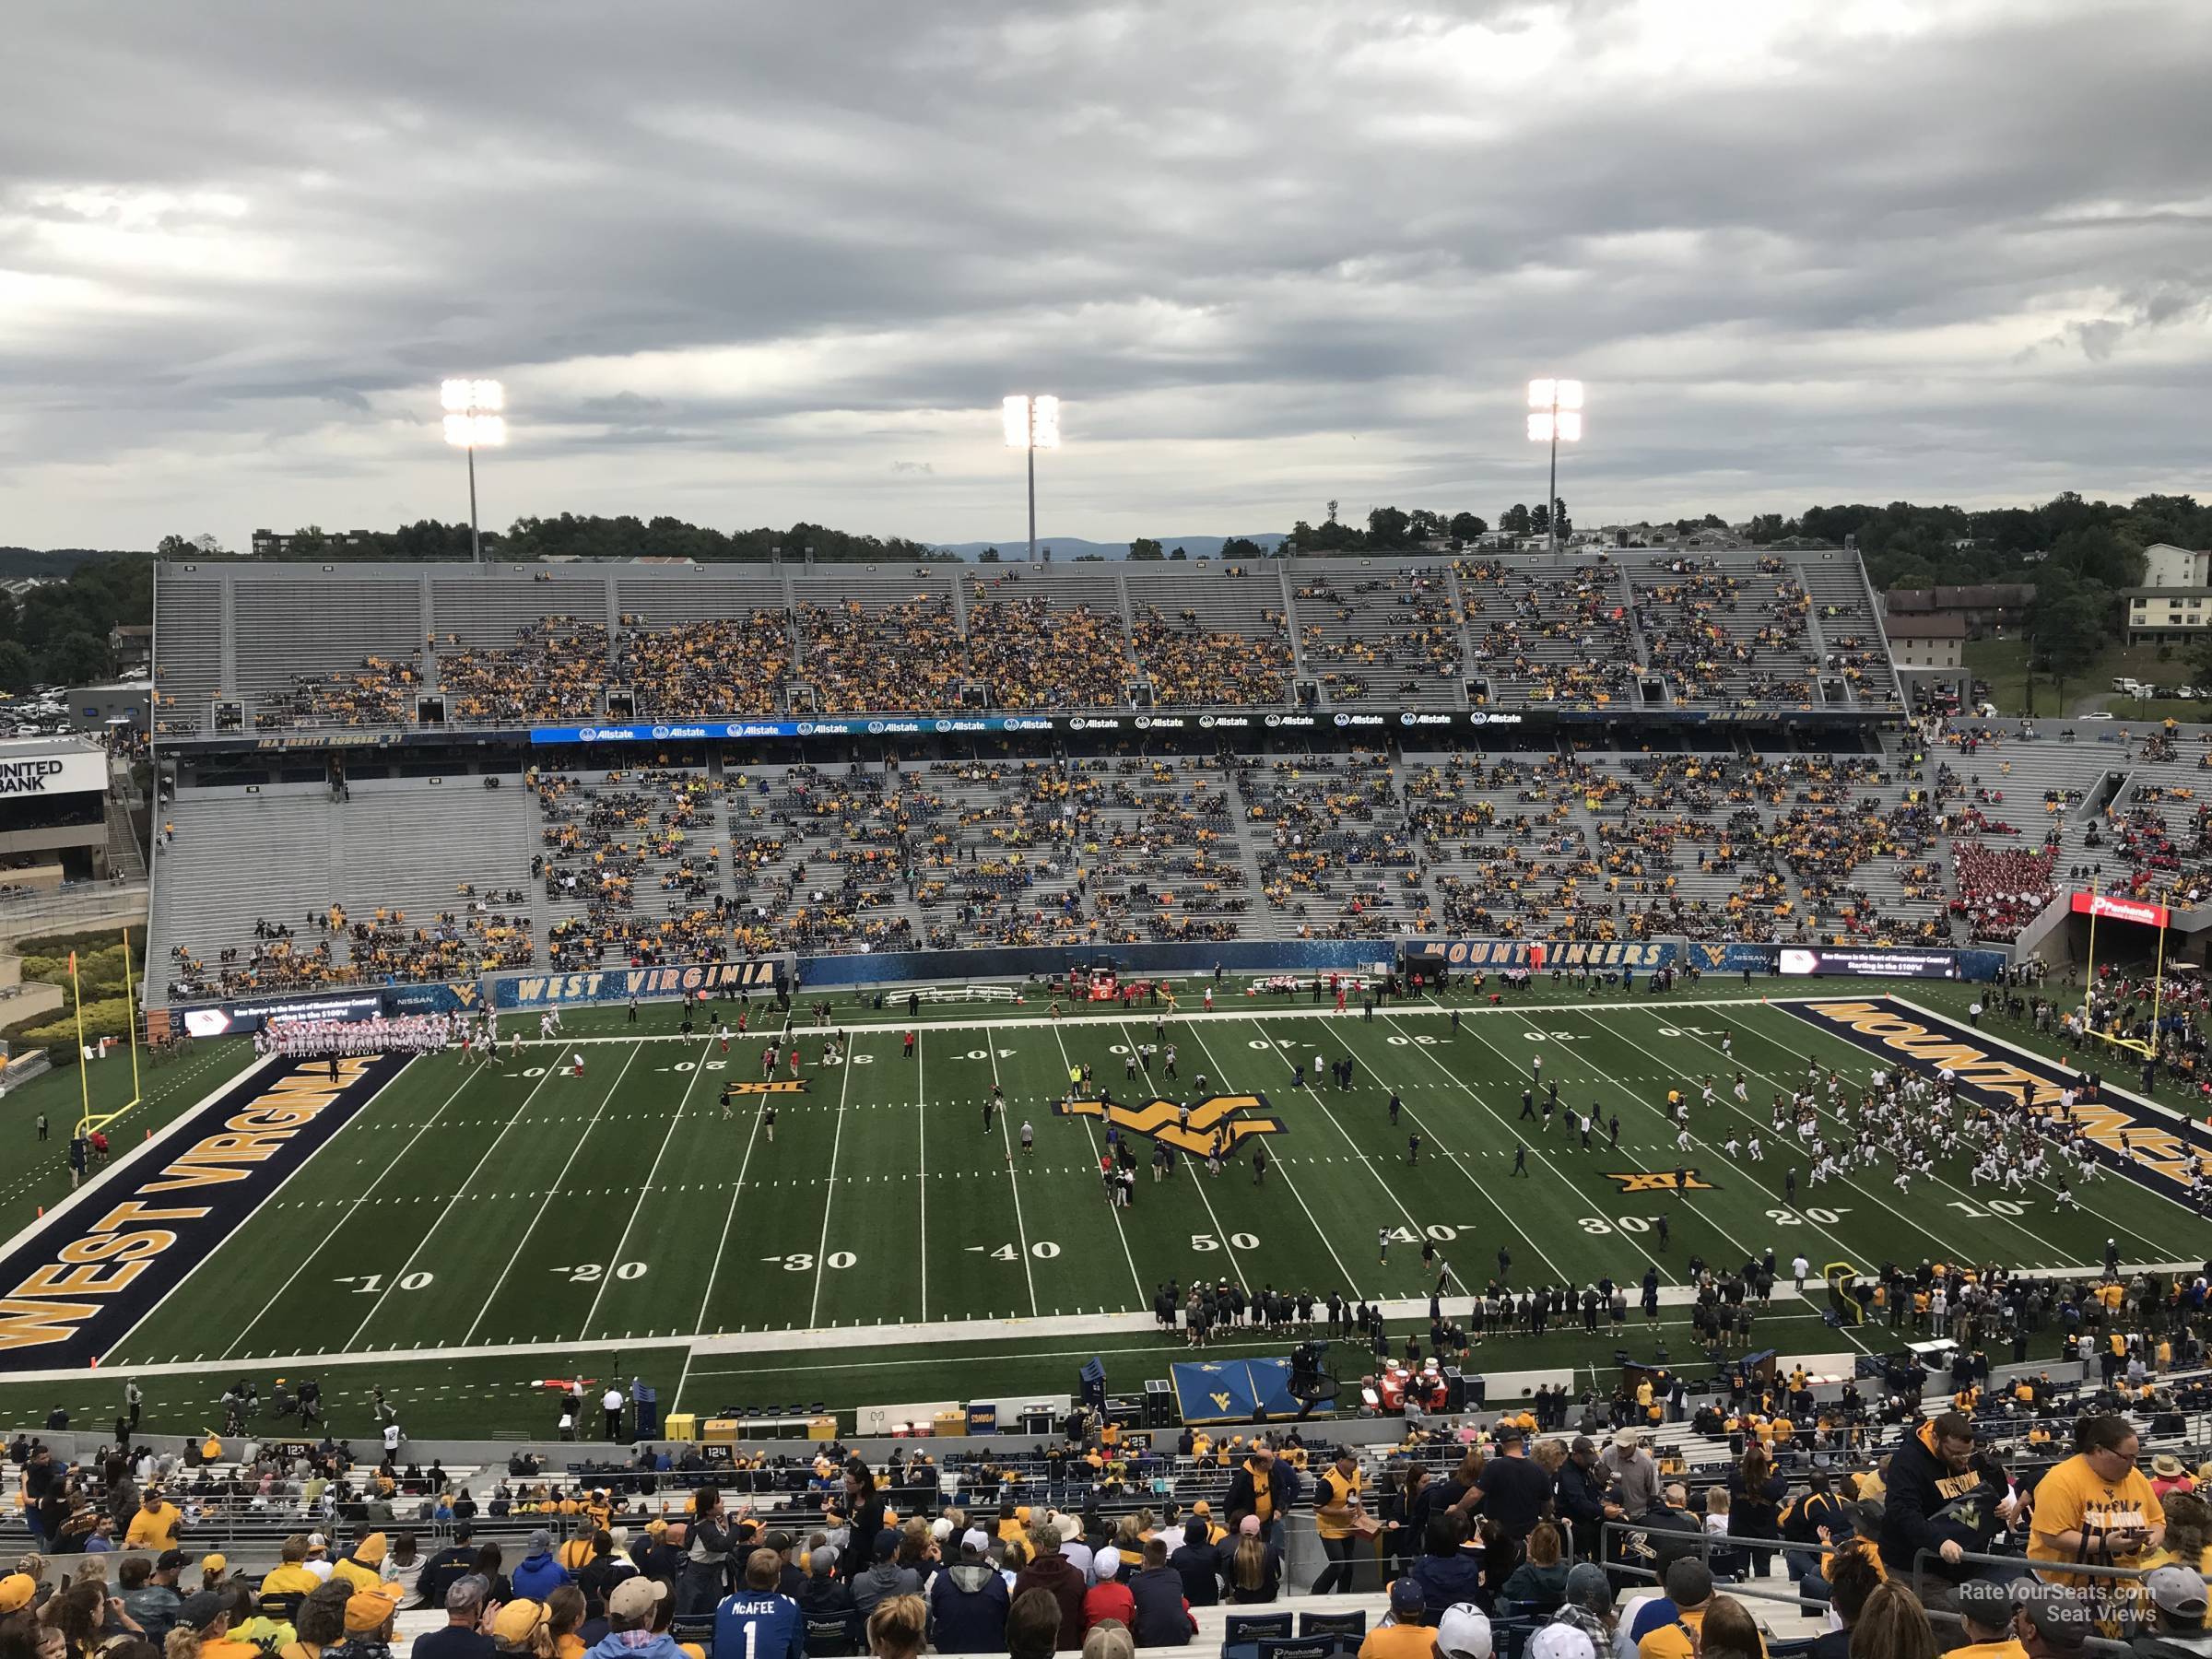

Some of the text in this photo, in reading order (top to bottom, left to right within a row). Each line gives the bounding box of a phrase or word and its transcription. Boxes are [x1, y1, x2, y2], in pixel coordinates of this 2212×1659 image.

[1086, 719, 1118, 728] Allstate
[1150, 718, 1183, 727] Allstate
[1215, 717, 1248, 726] Allstate
[1280, 716, 1313, 725] Allstate
[1349, 715, 1383, 724] Allstate
[1416, 715, 1450, 724] Allstate
[1487, 714, 1521, 724] Allstate
[813, 724, 848, 733] Allstate
[885, 724, 918, 732] Allstate
[951, 722, 984, 730] Allstate
[1019, 720, 1053, 729] Allstate
[597, 730, 633, 738] Allstate
[669, 728, 705, 736] Allstate
[744, 726, 779, 735] Allstate
[0, 760, 63, 777] NITED
[1423, 943, 1661, 965] MOUNTINEERS
[1848, 961, 1876, 970] Starting
[518, 962, 774, 1001] WEST VIRGINIA
[396, 996, 433, 1005] NISSAN
[1524, 1031, 1575, 1041] 20
[1658, 1027, 1716, 1037] 10
[1248, 1040, 1302, 1049] 40
[1387, 1036, 1436, 1045] 30
[826, 1054, 874, 1065] 30
[968, 1049, 1017, 1060] 40
[674, 1061, 727, 1071] 20
[517, 1066, 578, 1077] 10
[135, 1054, 383, 1194] VIRGINIA
[1947, 1200, 2026, 1218] 10
[1766, 1207, 1841, 1226] 20
[1577, 1216, 1651, 1234] 30
[1389, 1224, 1459, 1243] 40
[1191, 1232, 1261, 1253] 50
[991, 1241, 1062, 1261] 40
[783, 1251, 858, 1272] 30
[0, 1201, 213, 1351] WEST
[569, 1262, 649, 1283] 20
[352, 1272, 435, 1293] 10
[1129, 1436, 1147, 1447] 25
[287, 1445, 305, 1456] 123
[708, 1446, 727, 1458] 124
[732, 1601, 774, 1615] McAFEE
[743, 1621, 757, 1659] 1
[1284, 1647, 1324, 1657] Panhandle
